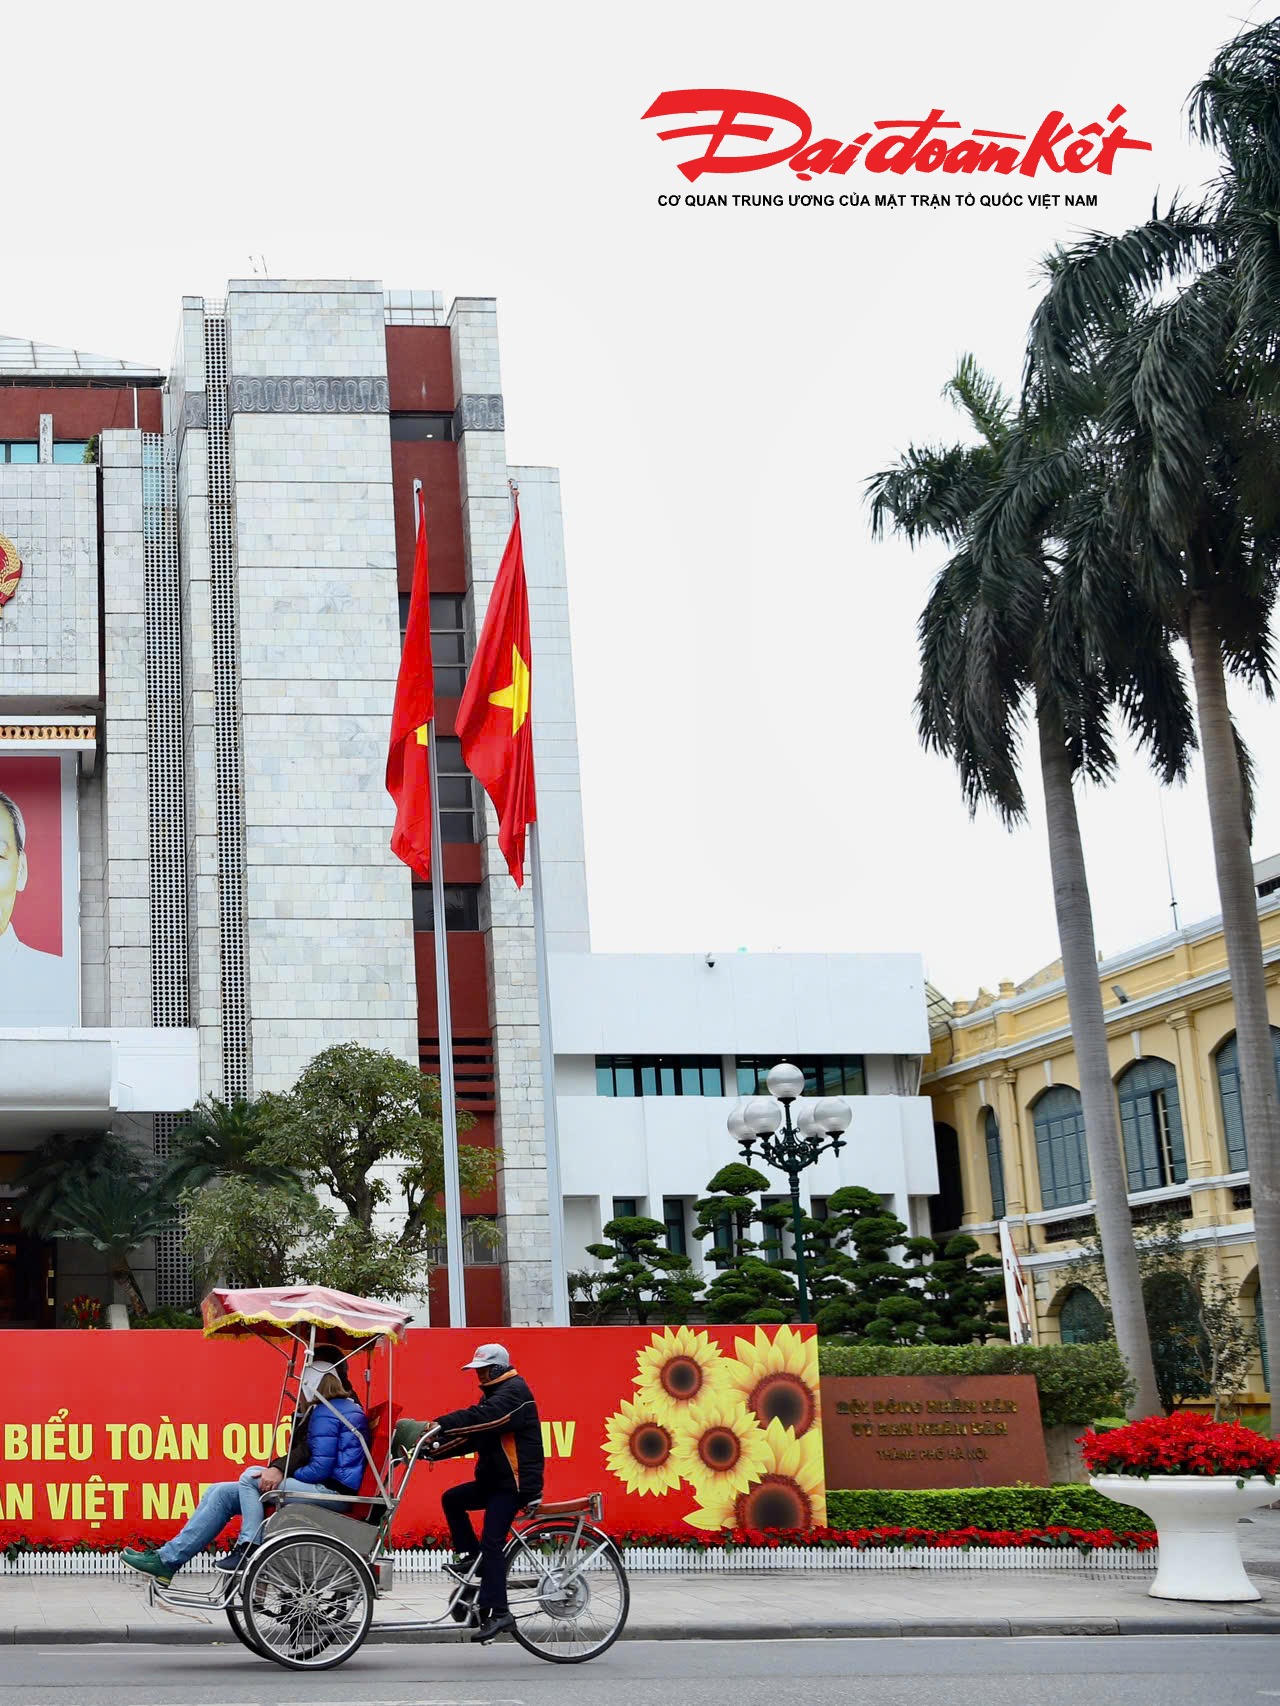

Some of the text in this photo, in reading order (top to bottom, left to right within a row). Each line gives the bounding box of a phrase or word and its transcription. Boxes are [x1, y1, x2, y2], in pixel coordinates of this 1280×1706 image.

[4, 1408, 93, 1461] BIỂU
[105, 1416, 209, 1461] TOÀN
[541, 1421, 576, 1458] IV
[46, 1474, 129, 1529] VIỆT
[142, 1482, 213, 1520] NA
